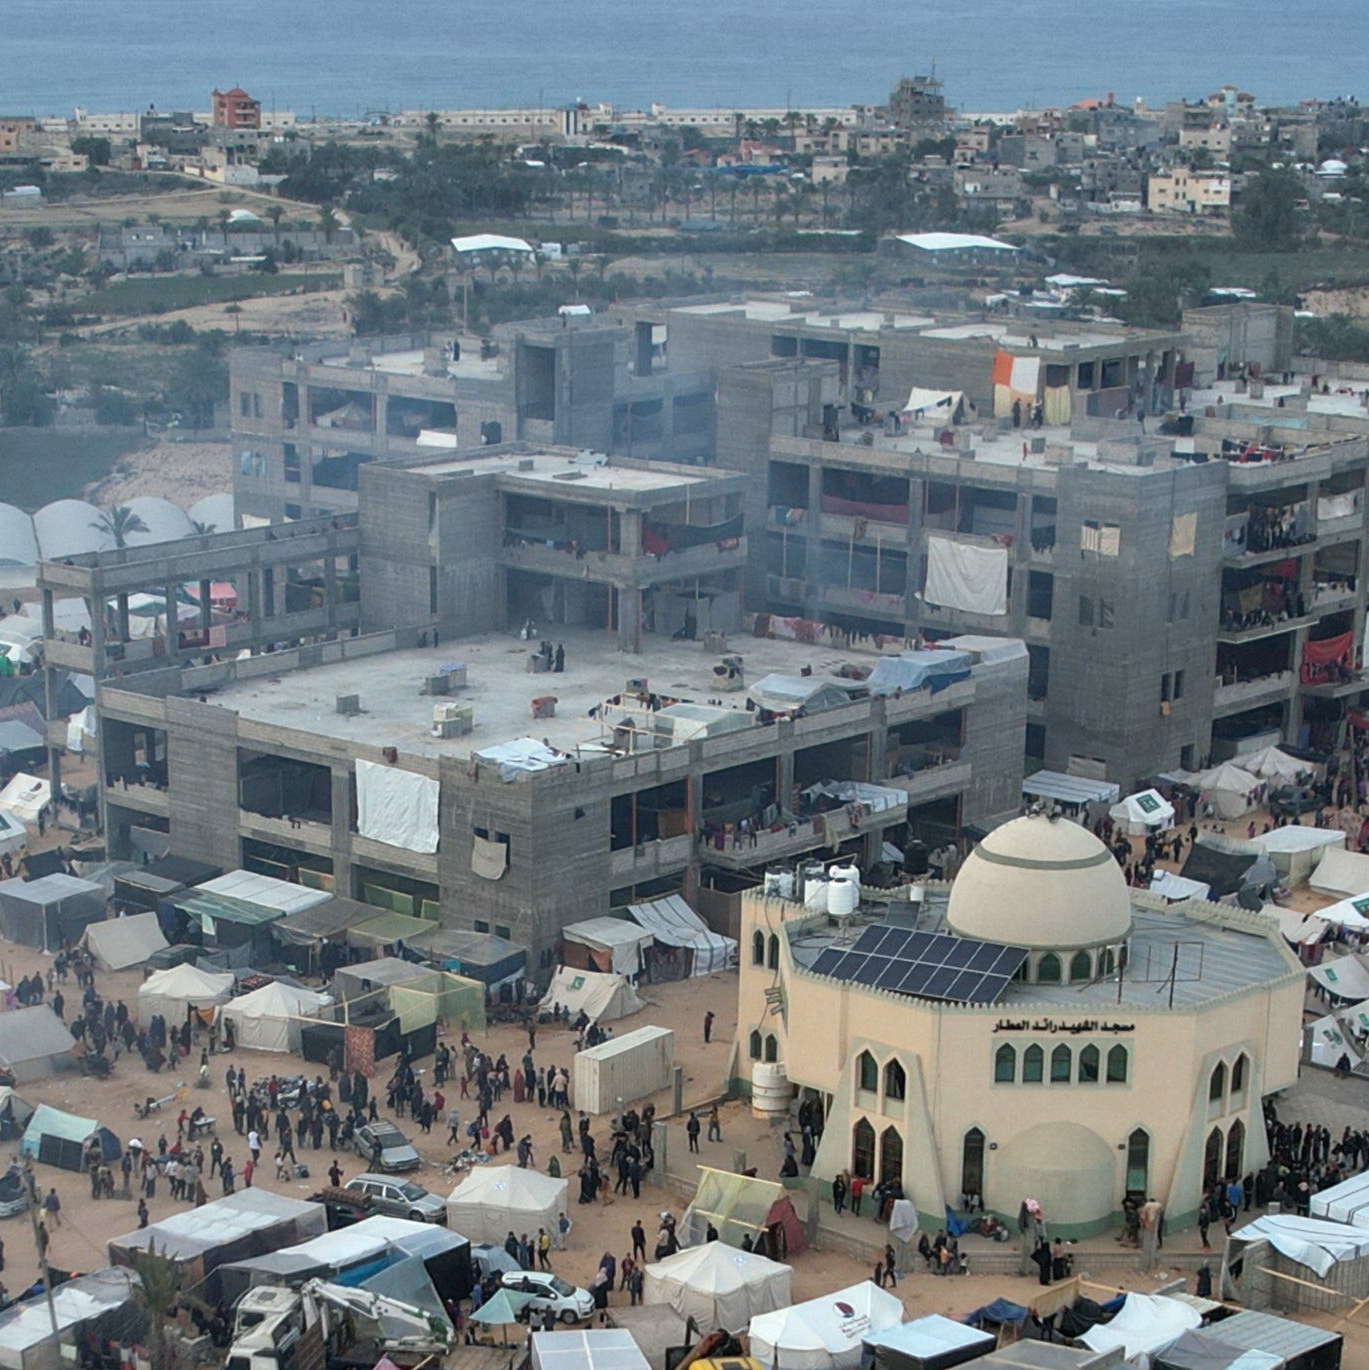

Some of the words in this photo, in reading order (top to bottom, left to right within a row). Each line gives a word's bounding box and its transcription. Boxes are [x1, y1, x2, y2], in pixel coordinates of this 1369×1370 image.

[992, 1019, 1030, 1032] العطار
[1032, 1018, 1057, 1034] رائد
[1059, 1019, 1098, 1034] الشهيد
[1100, 1021, 1135, 1034] مسجد
